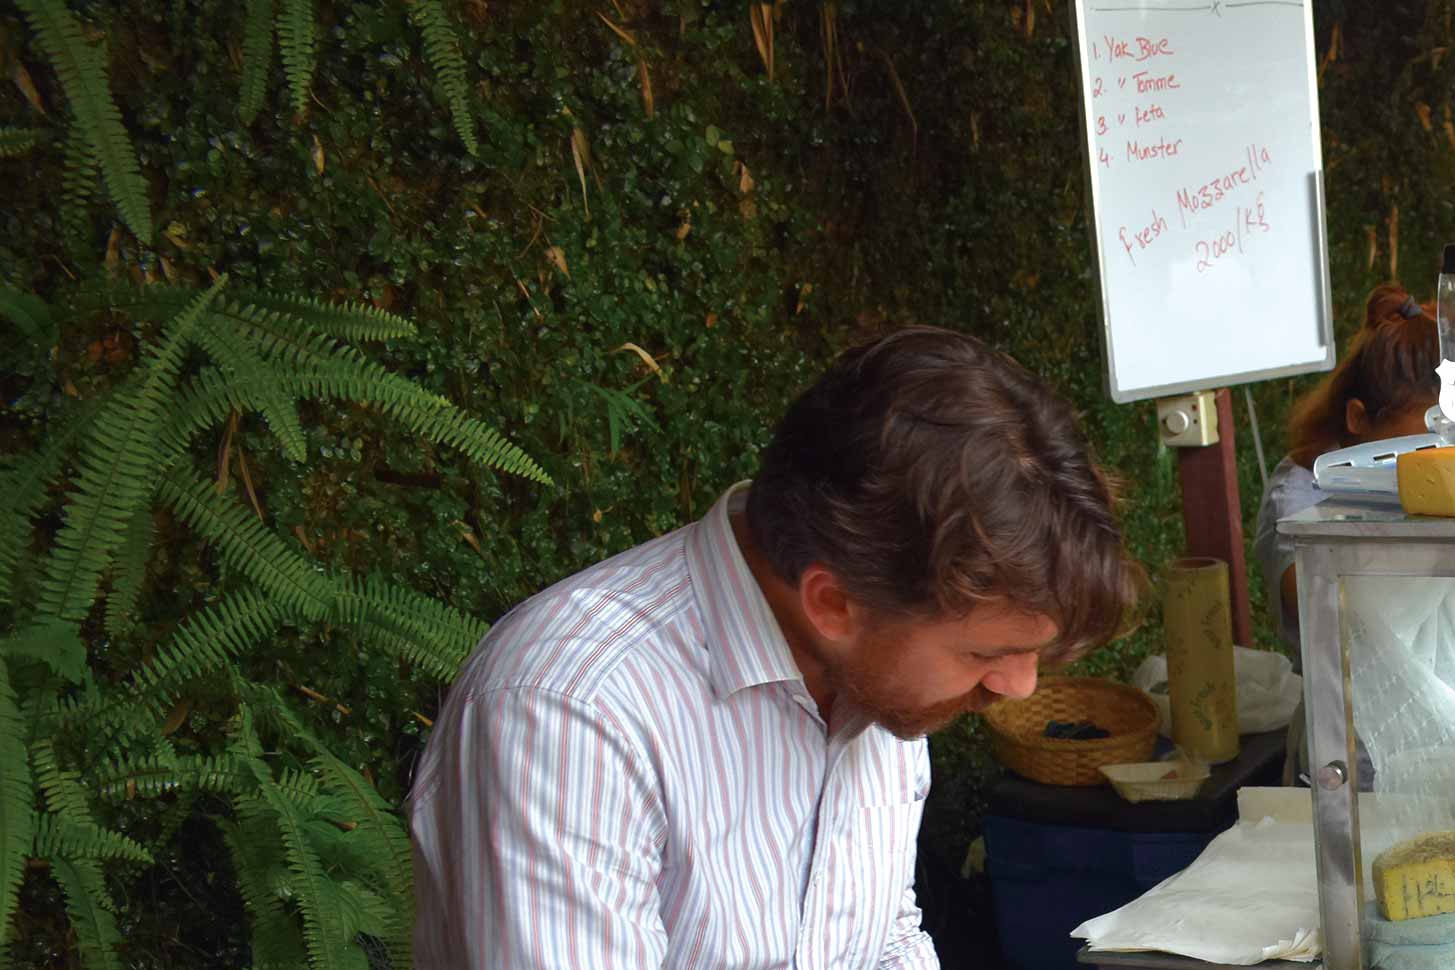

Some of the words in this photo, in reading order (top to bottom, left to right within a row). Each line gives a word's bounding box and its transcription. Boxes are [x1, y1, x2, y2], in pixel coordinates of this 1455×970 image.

[1104, 35, 1135, 63] Yak
[1132, 71, 1181, 93] Tomme
[1126, 136, 1184, 162] Munster
